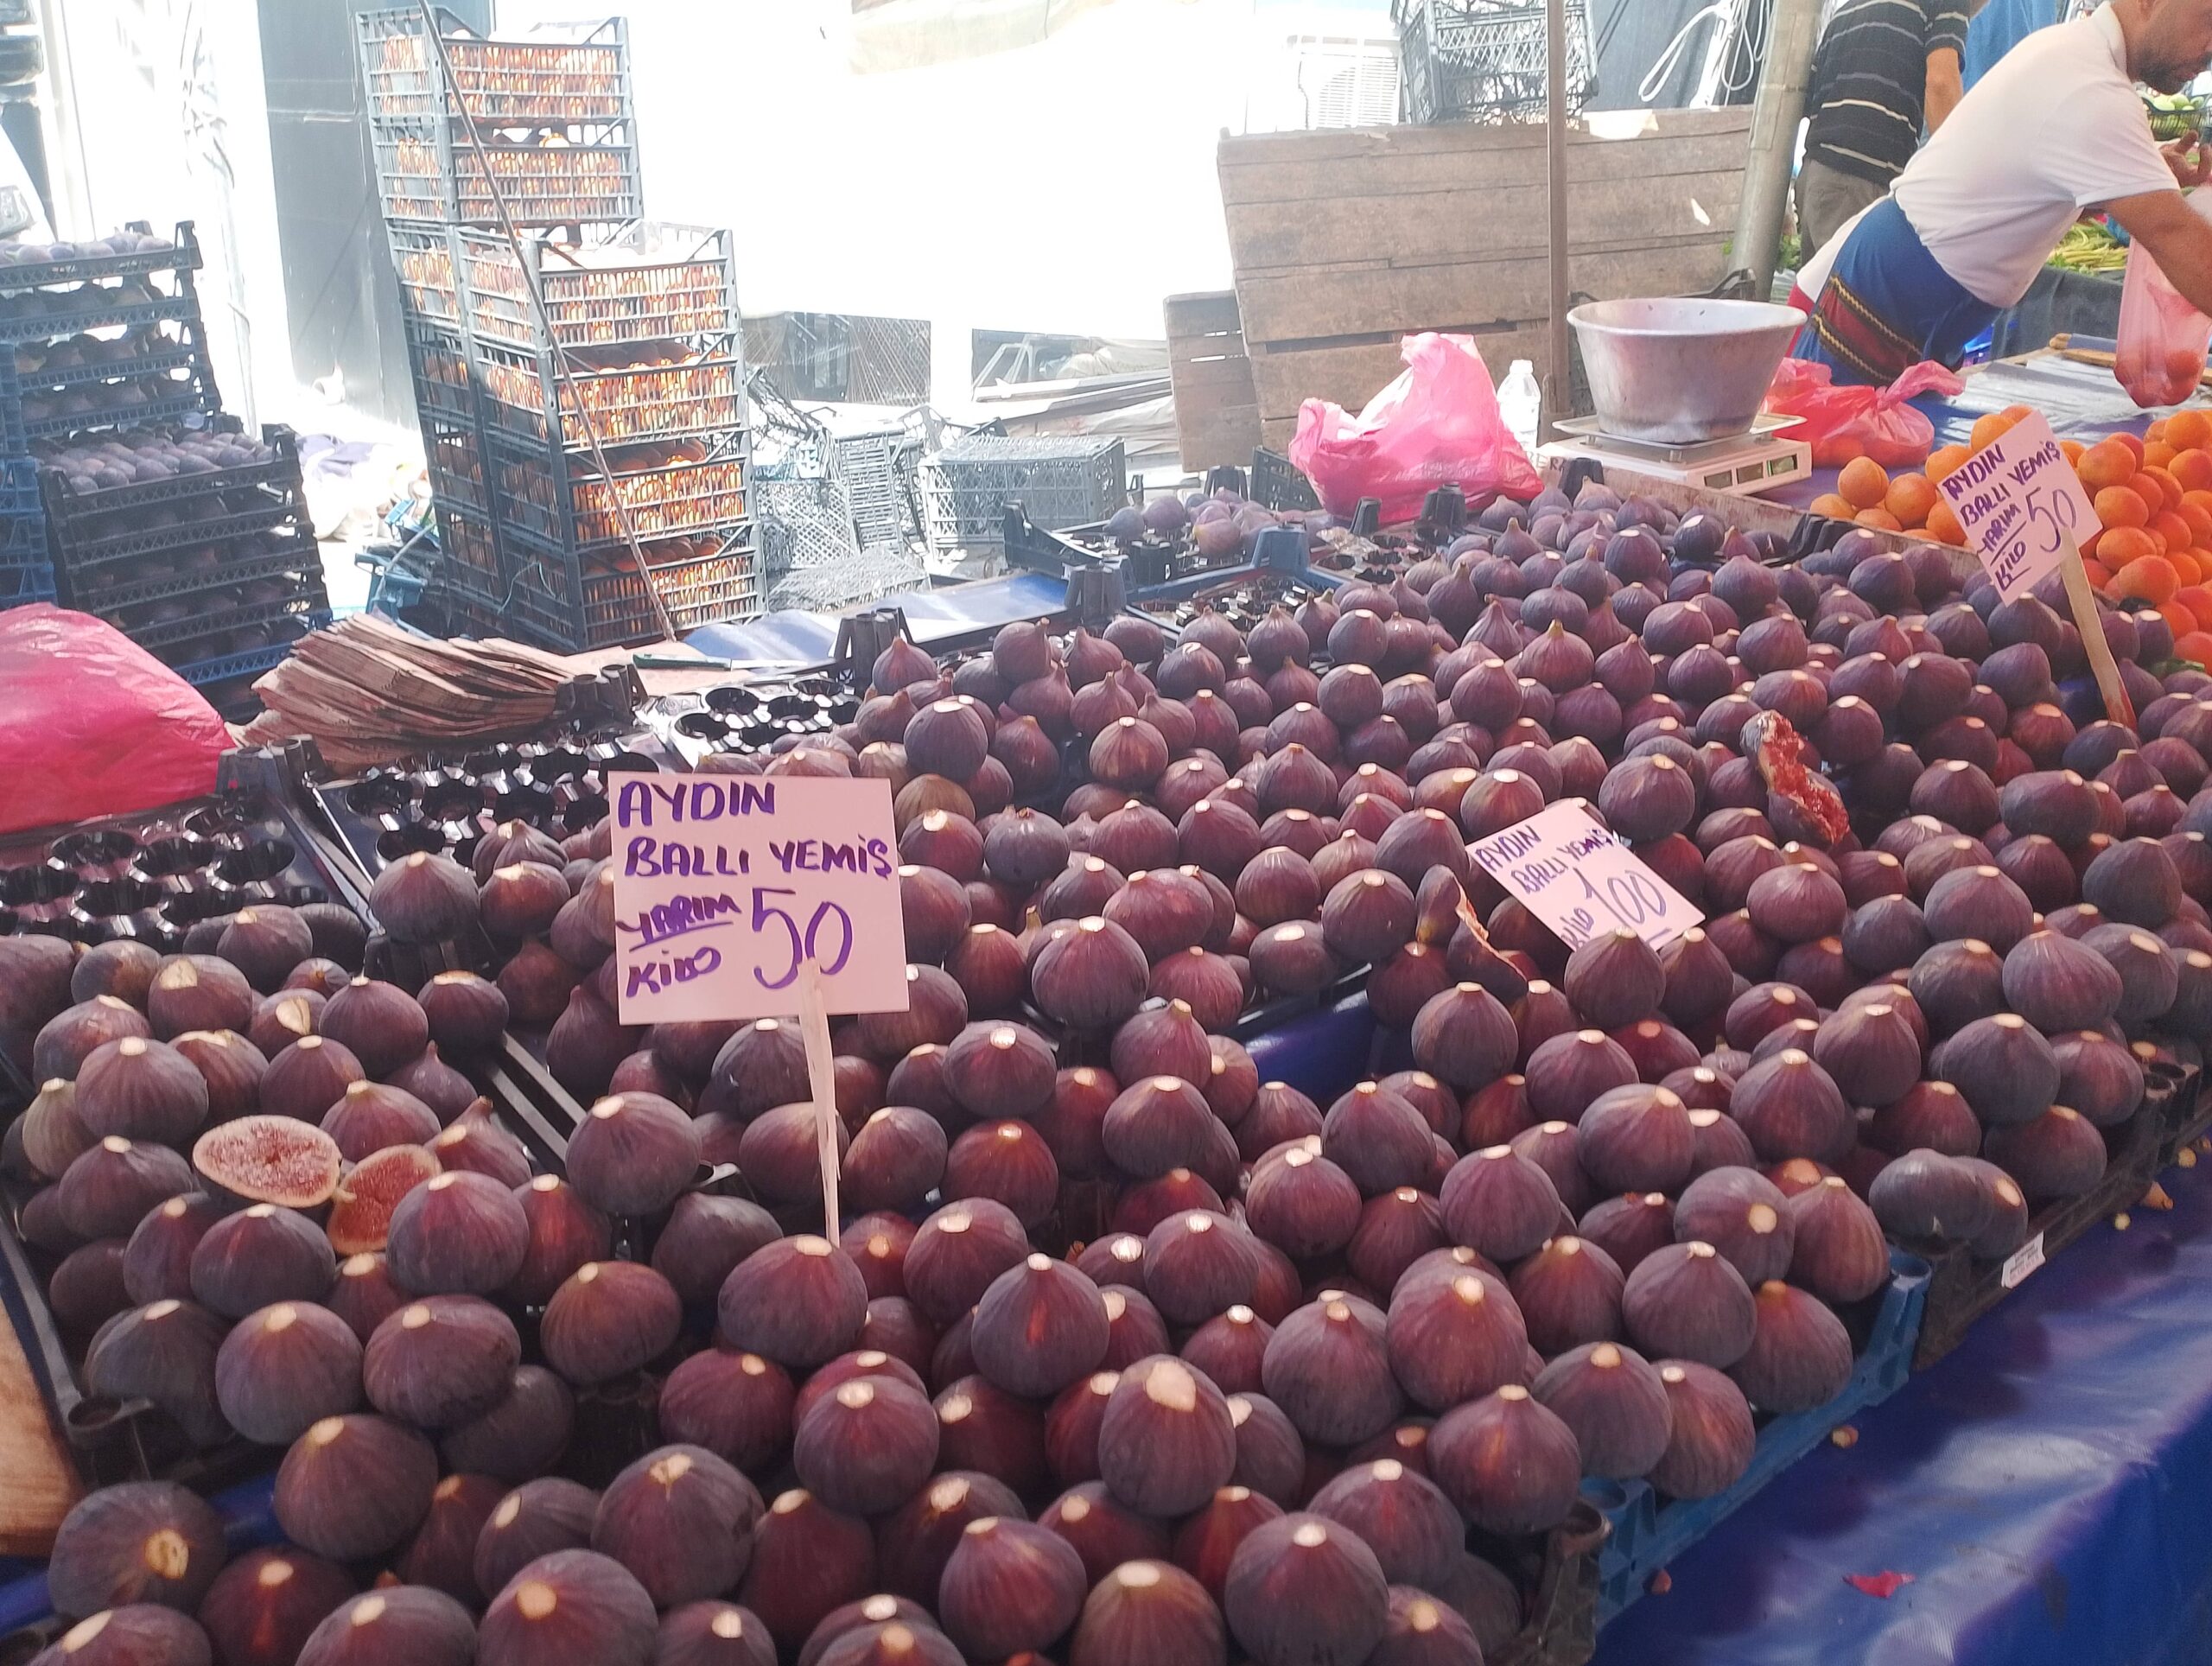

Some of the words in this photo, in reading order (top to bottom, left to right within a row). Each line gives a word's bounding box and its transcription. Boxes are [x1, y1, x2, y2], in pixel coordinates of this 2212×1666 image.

[1942, 443, 2005, 500] AYDIN
[1960, 483, 2011, 526] BALLI
[1977, 503, 2022, 554] YARIM
[2025, 486, 2077, 553] 50
[618, 780, 775, 828] AYDIN
[625, 836, 749, 876] BALLI
[1475, 824, 1541, 872] AYDIN
[1510, 856, 1568, 894] BALLI
[1573, 866, 1667, 928] 100
[615, 893, 742, 944] YARIM
[752, 887, 853, 989] 50
